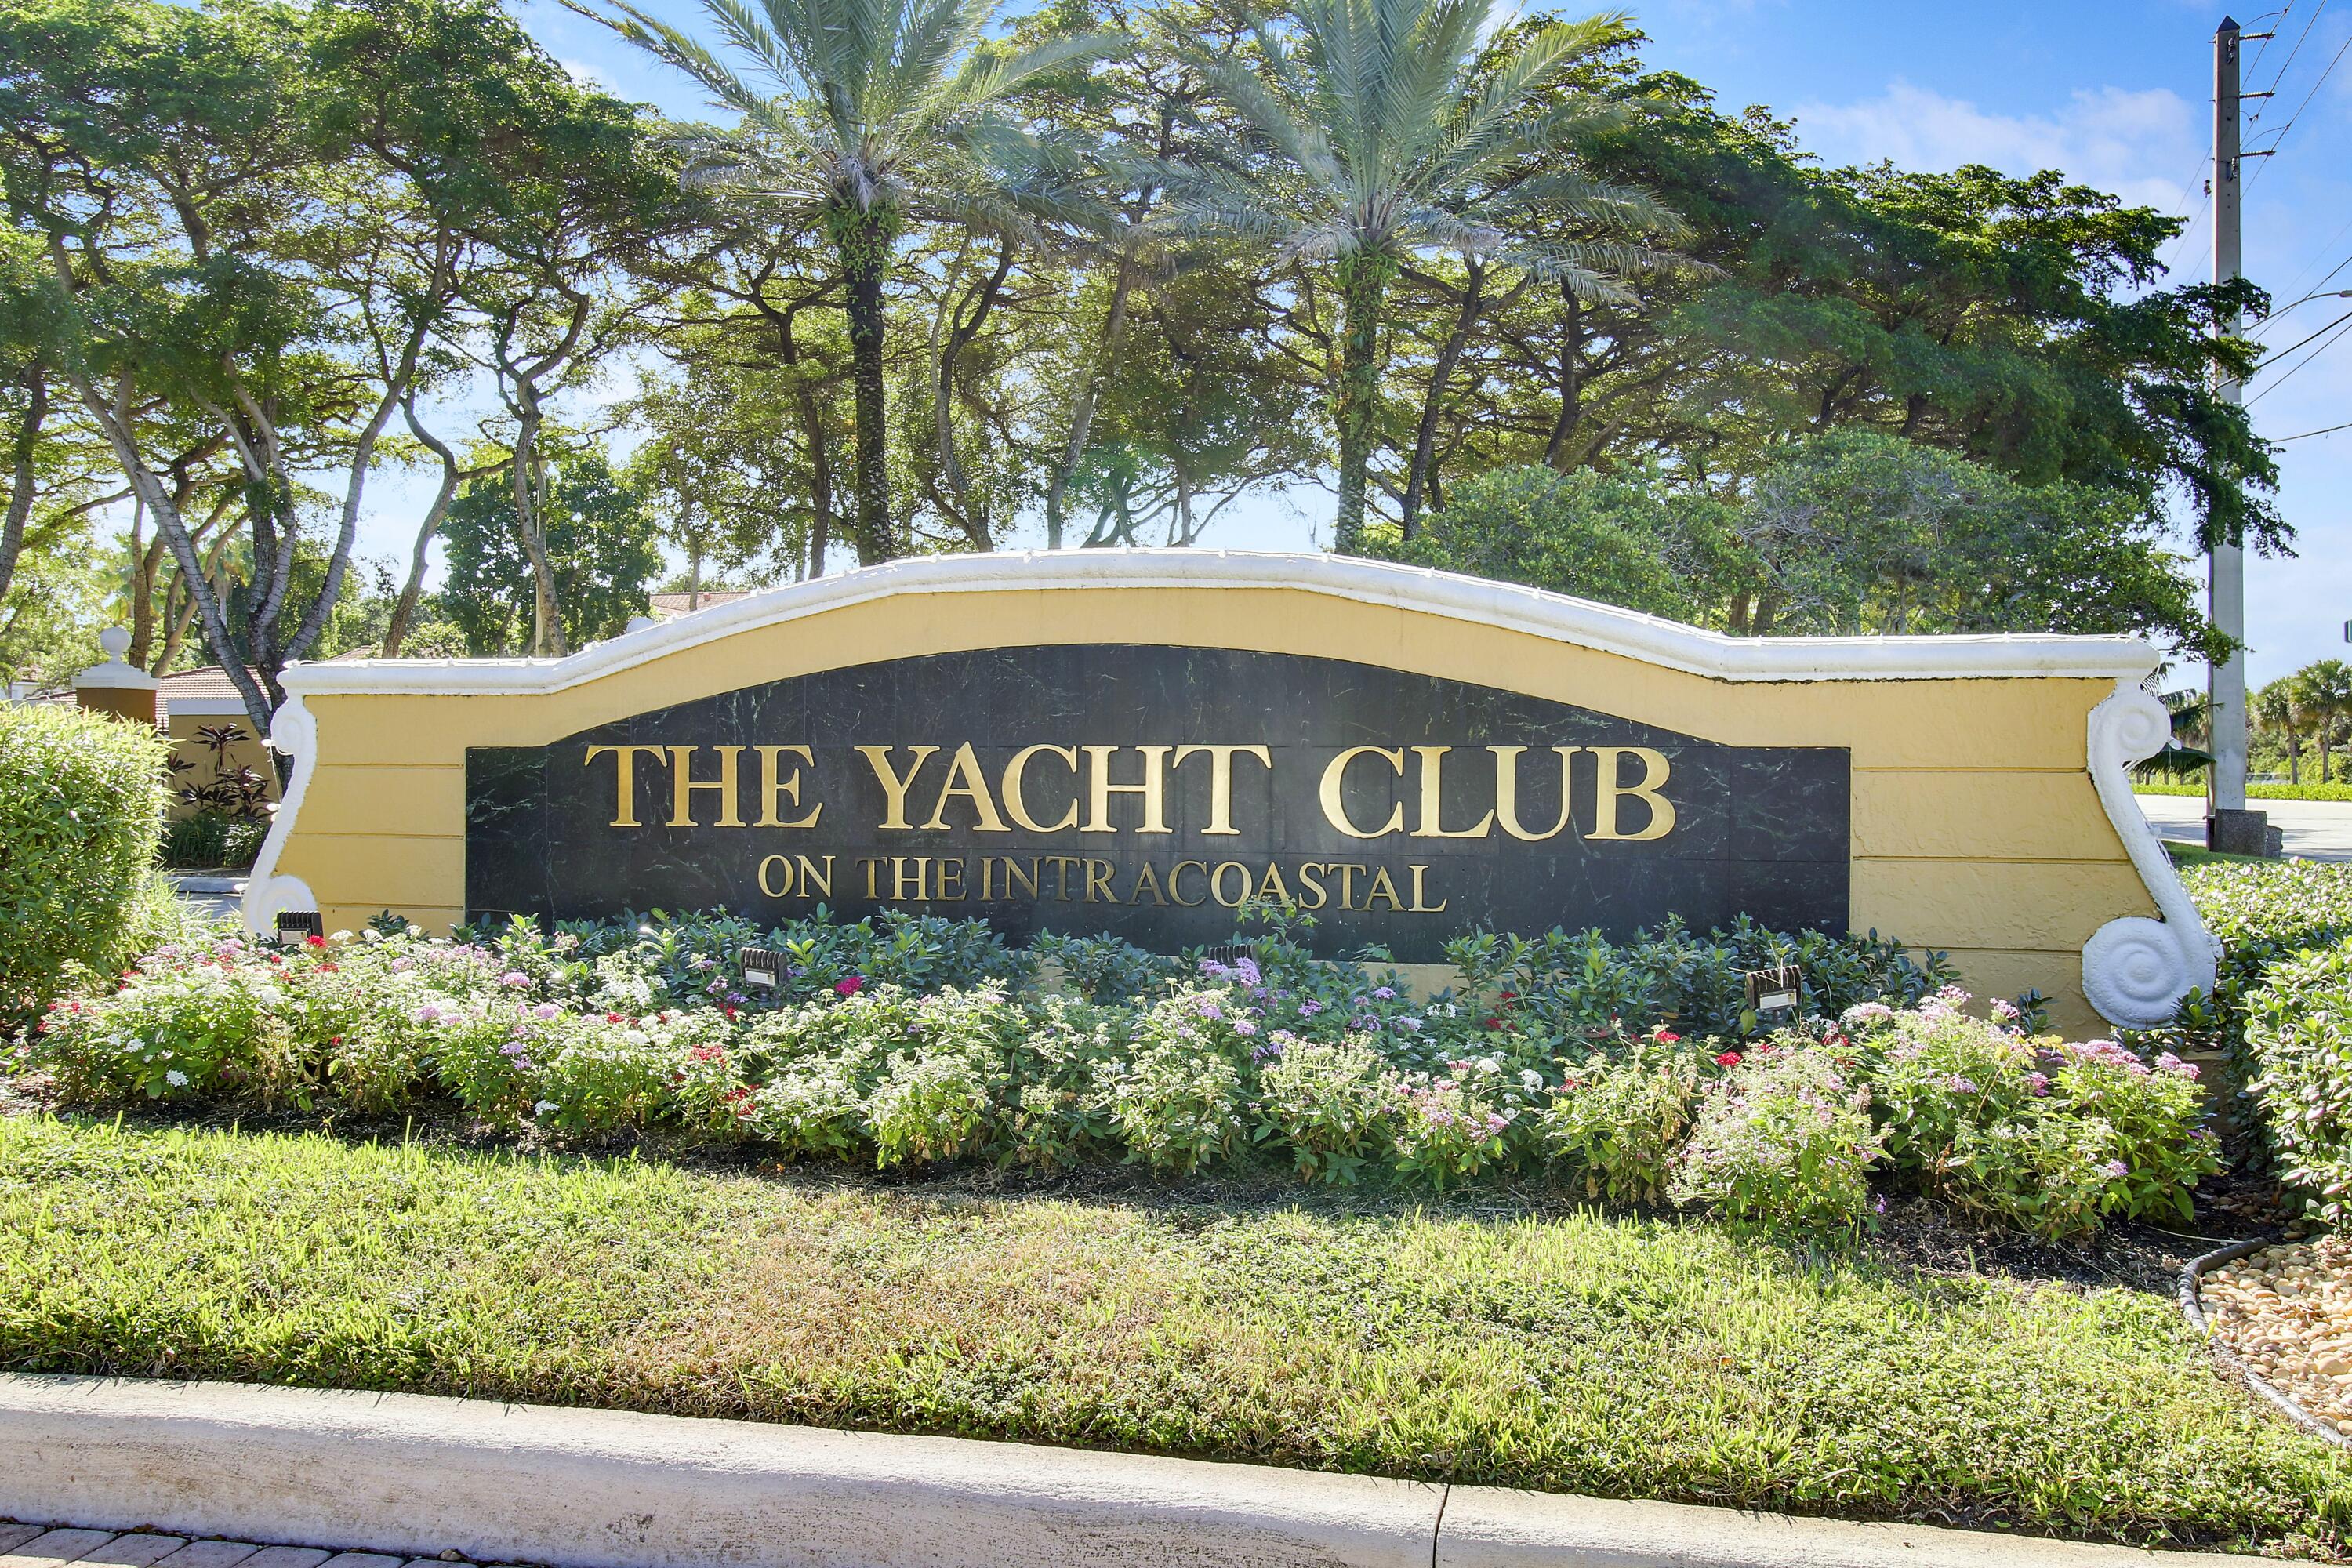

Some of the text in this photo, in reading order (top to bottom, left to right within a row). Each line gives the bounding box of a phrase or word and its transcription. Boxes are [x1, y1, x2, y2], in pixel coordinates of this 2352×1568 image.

[584, 740, 1677, 841] THE YACHT CLUB
[757, 854, 1447, 912] ON THE INTRACOASTAL
